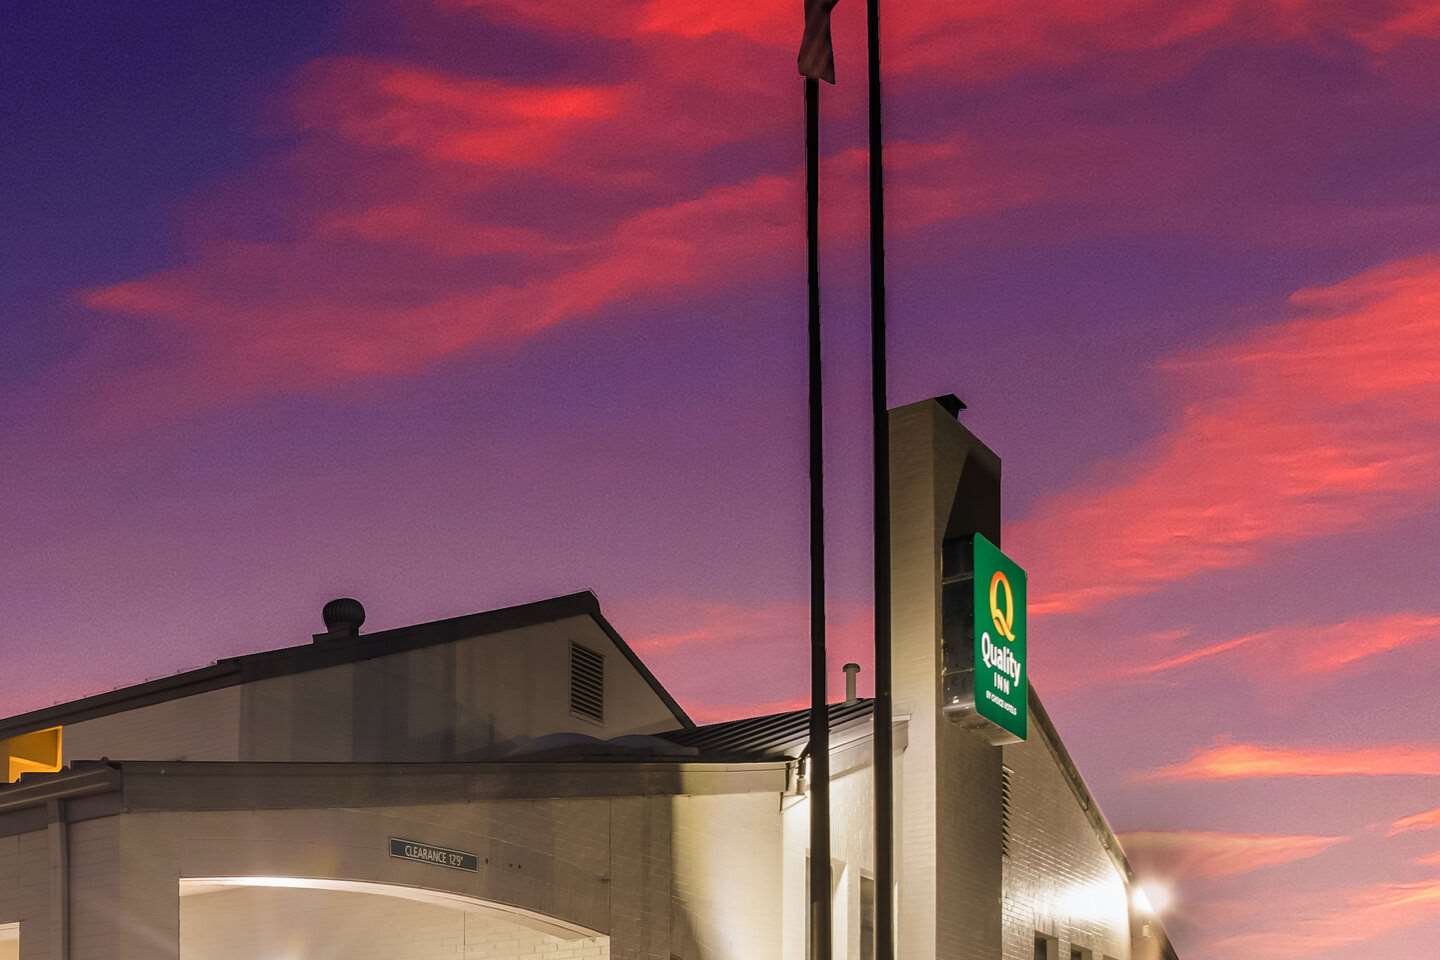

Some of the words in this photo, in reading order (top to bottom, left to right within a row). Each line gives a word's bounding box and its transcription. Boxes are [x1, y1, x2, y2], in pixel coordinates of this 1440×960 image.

[989, 571, 1015, 642] Q
[981, 632, 1021, 687] Quality
[993, 671, 1010, 695] INN
[404, 845, 447, 864] CLEARANCE
